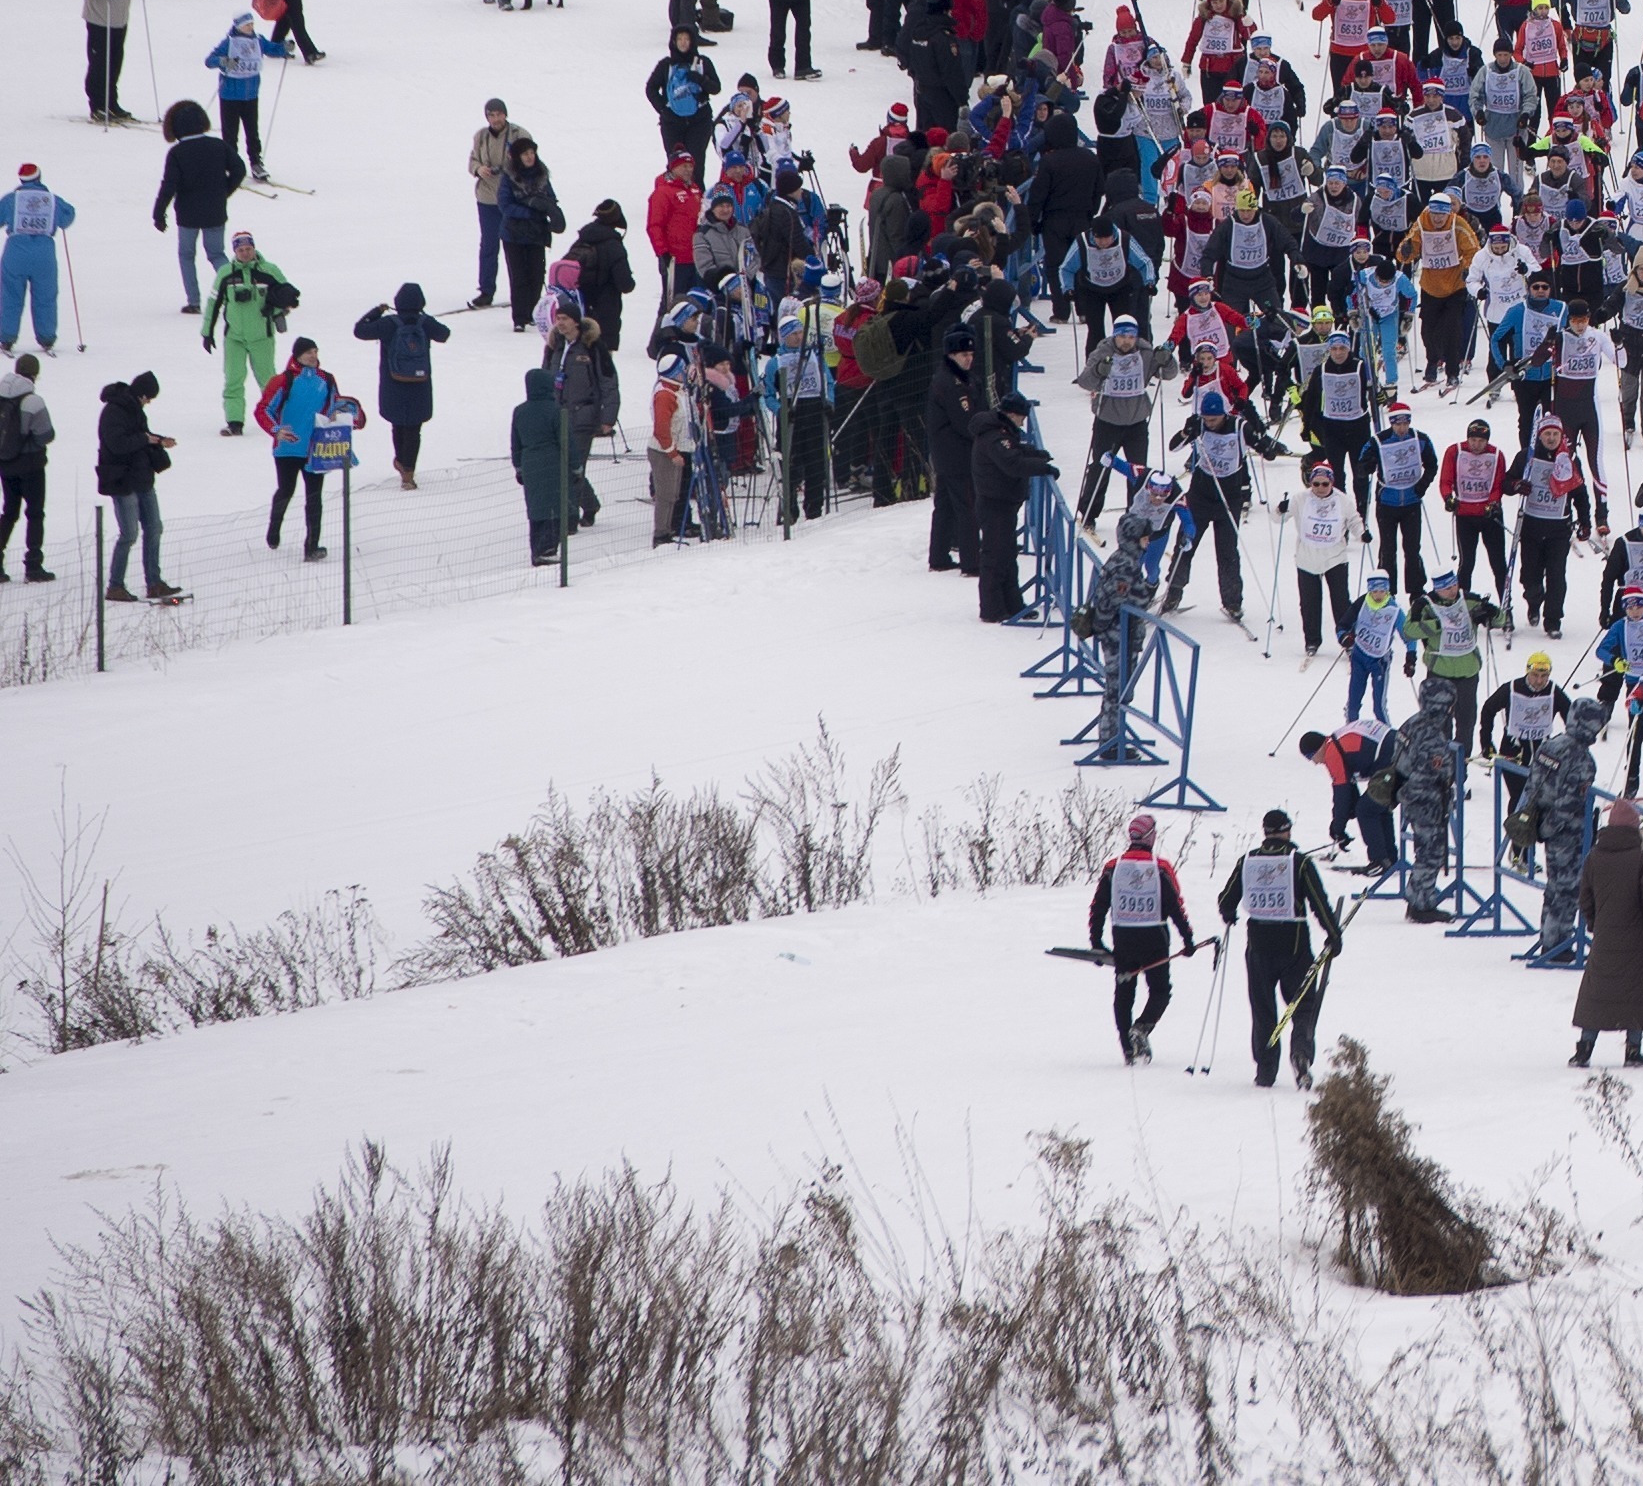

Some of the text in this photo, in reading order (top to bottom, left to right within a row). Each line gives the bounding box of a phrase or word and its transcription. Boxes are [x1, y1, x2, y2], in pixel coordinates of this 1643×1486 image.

[1341, 25, 1363, 34] 6635
[1493, 95, 1516, 105] 2865
[1240, 249, 1263, 260] 3773
[1429, 258, 1451, 267] 3801
[1568, 359, 1595, 370] 12636
[1113, 379, 1138, 390] 3891
[313, 440, 349, 459] ЛДПР
[1313, 524, 1332, 536] 573
[1119, 897, 1154, 911] 3959
[1250, 893, 1285, 908] 3958
